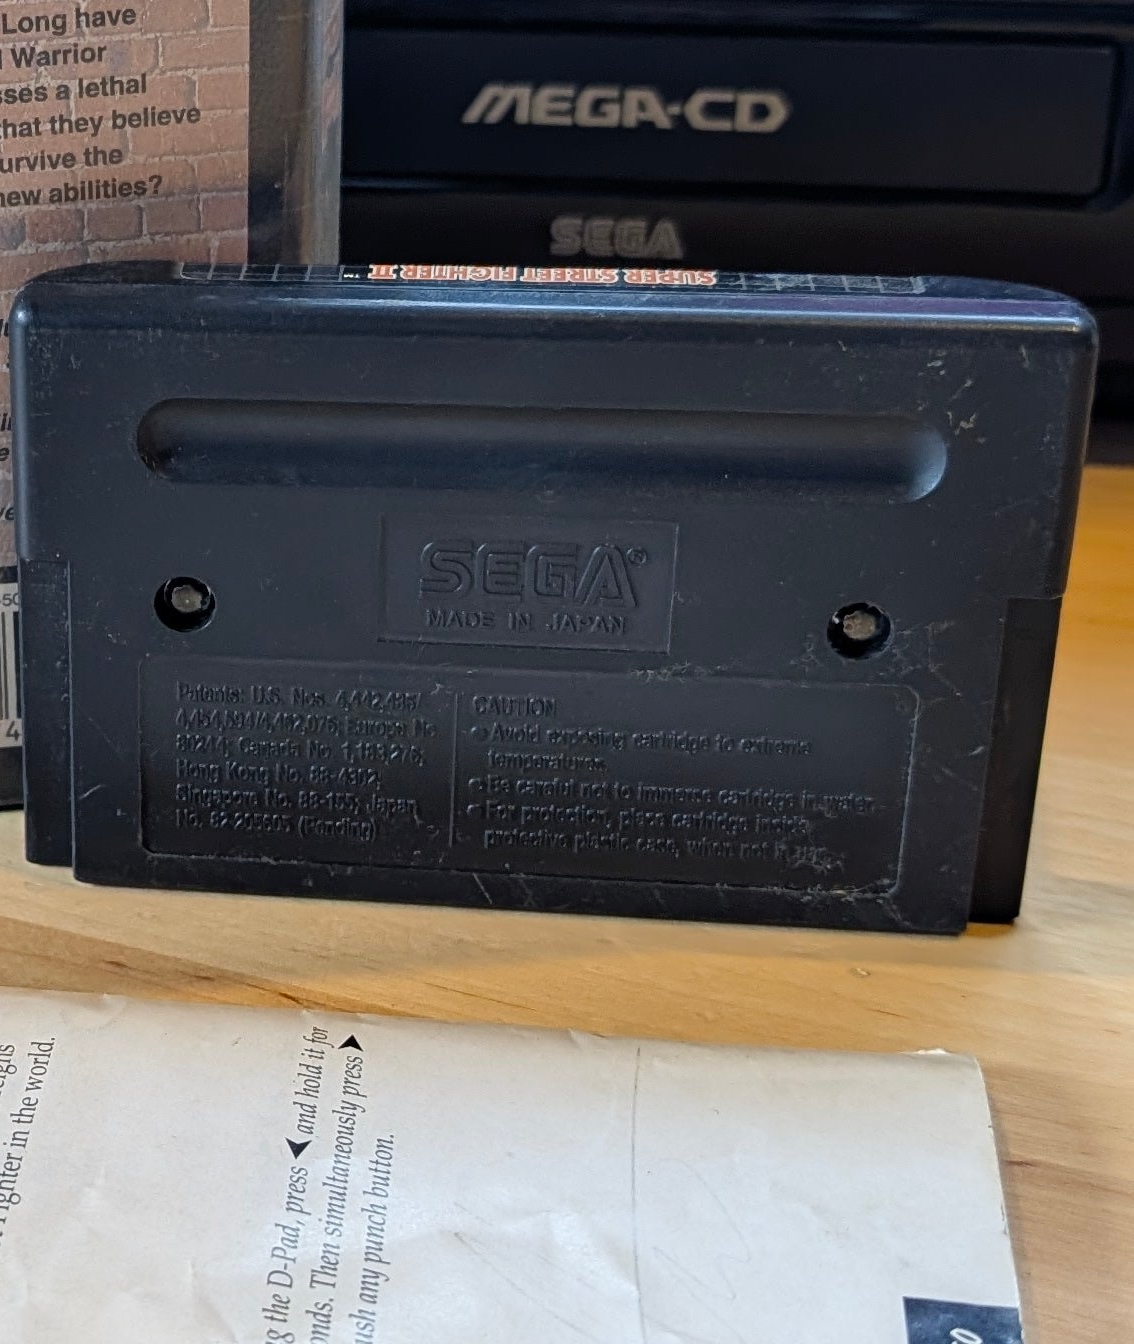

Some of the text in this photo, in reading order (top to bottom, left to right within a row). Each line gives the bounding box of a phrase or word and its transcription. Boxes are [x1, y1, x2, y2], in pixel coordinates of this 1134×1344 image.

[1, 13, 66, 36] Long
[75, 5, 136, 28] have
[463, 81, 794, 134] MEGA-CD
[548, 213, 686, 260] SEGA
[399, 264, 518, 282] FIGHTER
[521, 266, 619, 284] STREET
[623, 268, 718, 286] SUPER
[424, 607, 629, 637] MADE IN JAPAN
[362, 1134, 394, 1197] button.
[361, 1203, 390, 1265] punch
[358, 1267, 389, 1304] any
